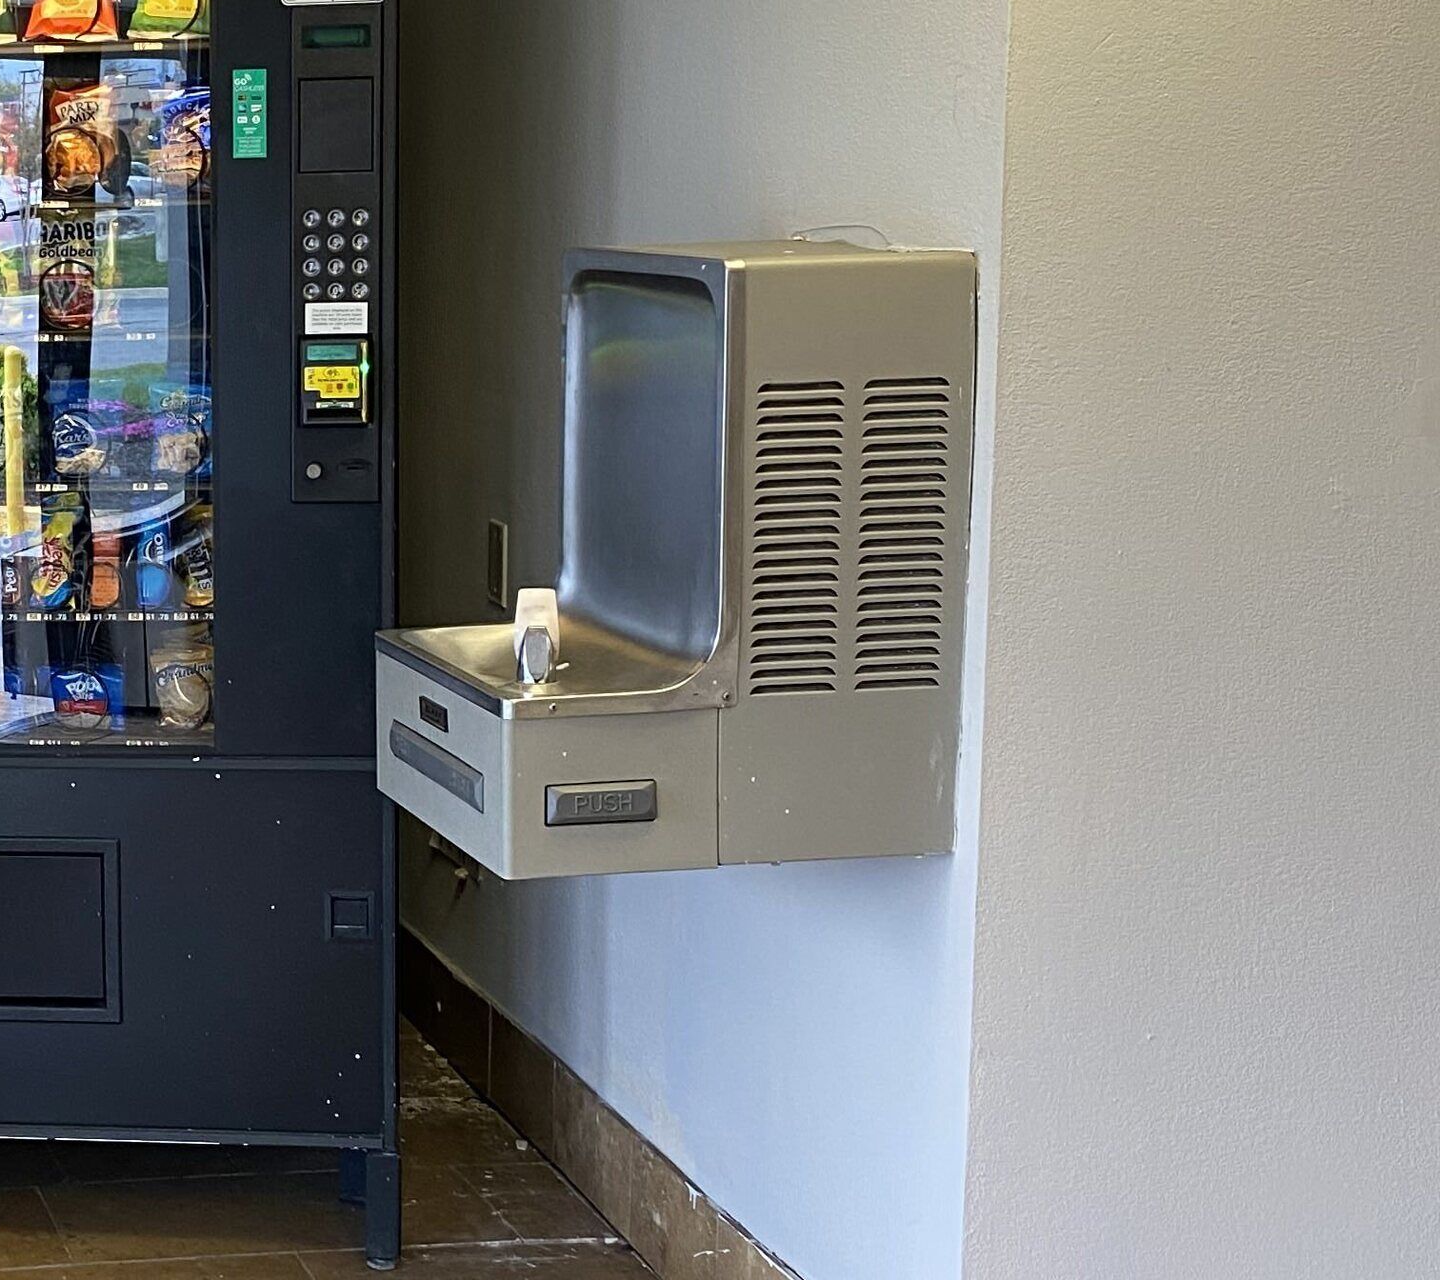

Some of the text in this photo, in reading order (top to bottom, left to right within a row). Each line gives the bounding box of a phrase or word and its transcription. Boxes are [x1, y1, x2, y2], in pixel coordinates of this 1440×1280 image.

[234, 78, 248, 86] GO
[60, 101, 104, 118] PARTY
[69, 110, 96, 125] MIX
[40, 221, 109, 243] HARIBO
[574, 794, 633, 814] PUSH
